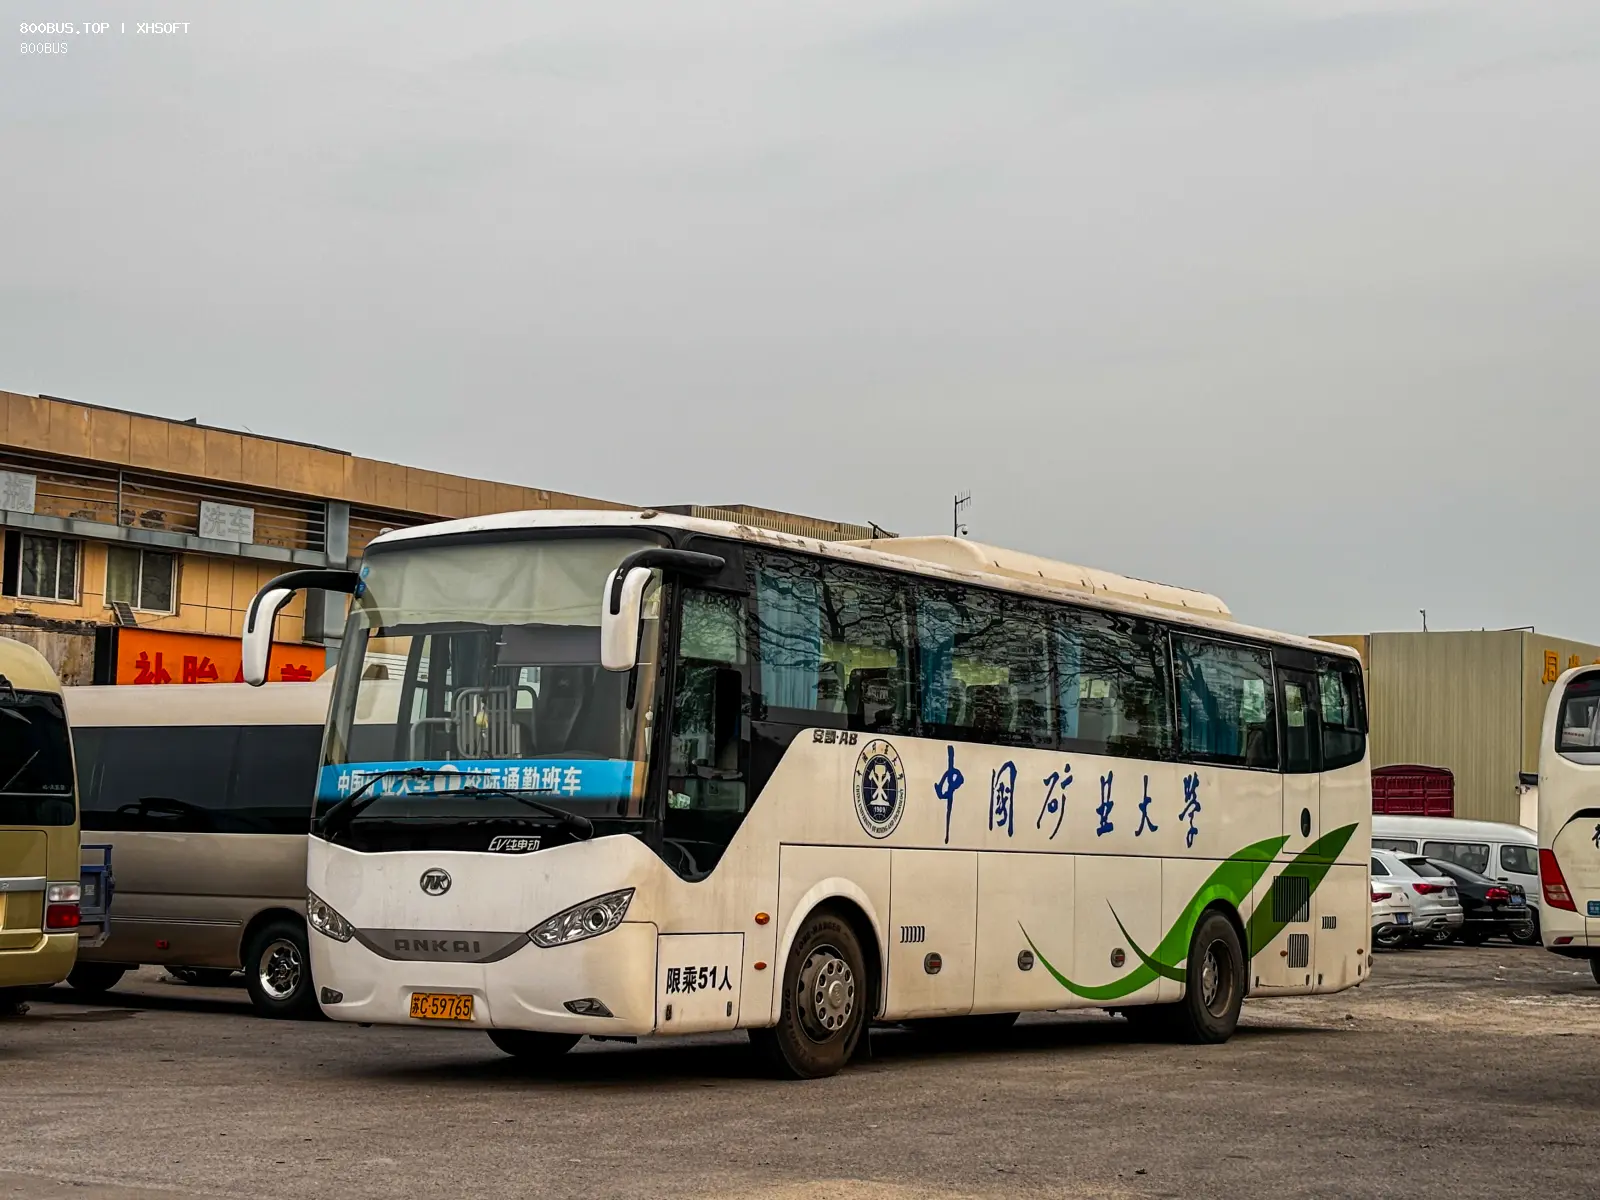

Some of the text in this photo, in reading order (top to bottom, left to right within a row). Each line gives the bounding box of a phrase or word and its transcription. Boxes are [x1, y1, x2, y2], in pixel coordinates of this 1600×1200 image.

[203, 505, 252, 541] 洗车
[134, 651, 313, 684] 补胎
[464, 766, 582, 796] 校际通勤班车
[394, 939, 480, 953] ANKAI
[666, 965, 732, 994] 限乘51人
